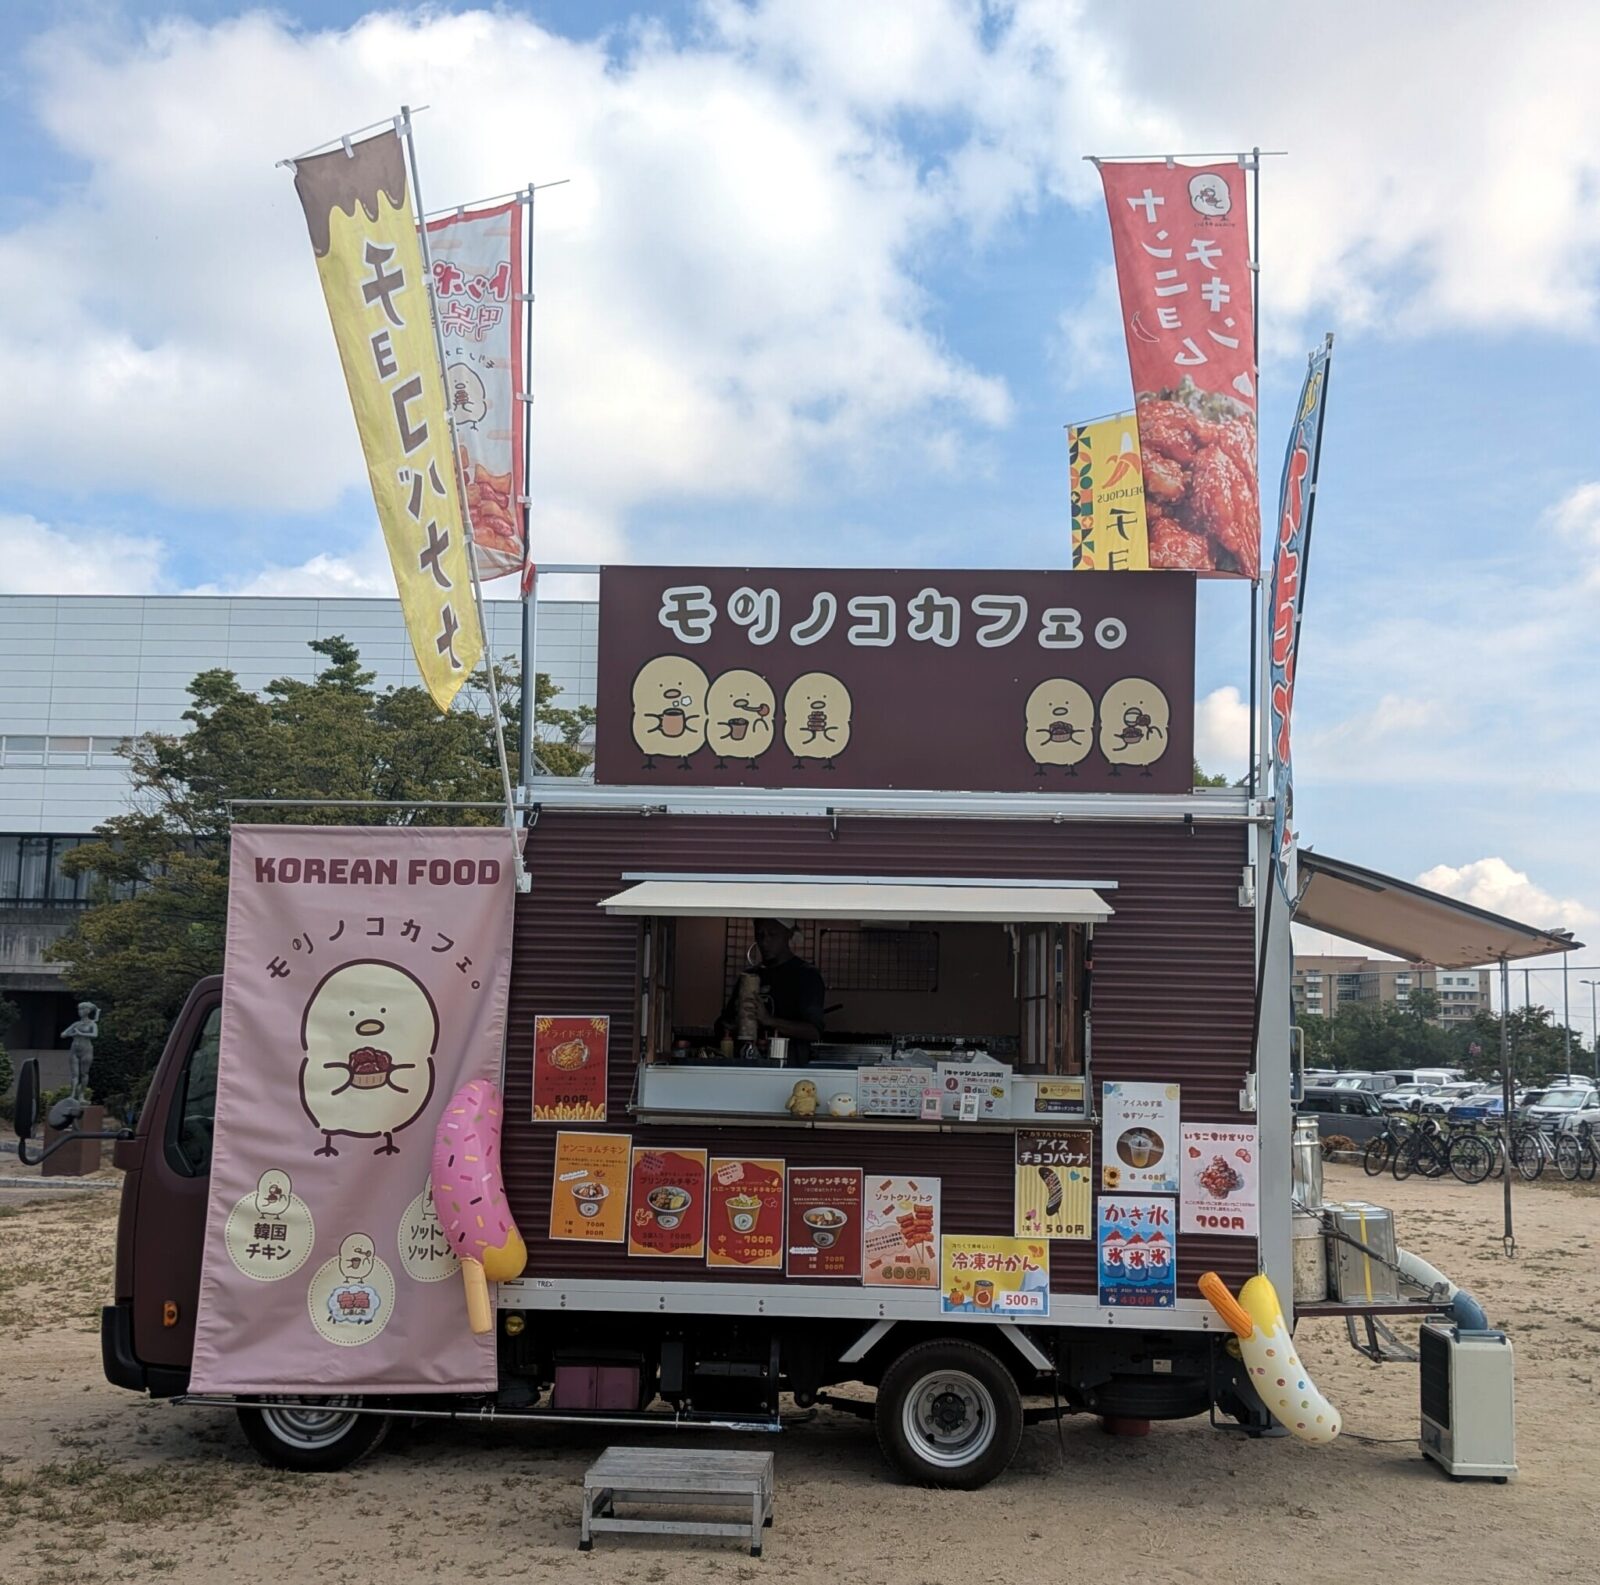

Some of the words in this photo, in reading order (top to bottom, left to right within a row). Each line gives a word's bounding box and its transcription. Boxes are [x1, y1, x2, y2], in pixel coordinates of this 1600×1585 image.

[254, 857, 398, 885] KOREAN
[407, 858, 501, 886] FOOD
[554, 1094, 588, 1104] 500円
[561, 1143, 627, 1155] ヤンニョムチキン
[1036, 1138, 1069, 1151] アイス
[1020, 1151, 1088, 1165] チョコバナナ
[1104, 1203, 1170, 1227] かき氷
[1195, 1214, 1245, 1230] 700円
[253, 1222, 288, 1242] 韓国
[1046, 1224, 1085, 1235] 500円
[718, 1234, 727, 1243] 中
[743, 1235, 774, 1245] 700円
[245, 1242, 292, 1261] チキン
[718, 1247, 727, 1256] 大
[743, 1248, 773, 1257] 900円
[951, 1252, 1040, 1272] 冷凍みかん
[881, 1265, 931, 1281] 600円
[1005, 1294, 1039, 1307] 500円
